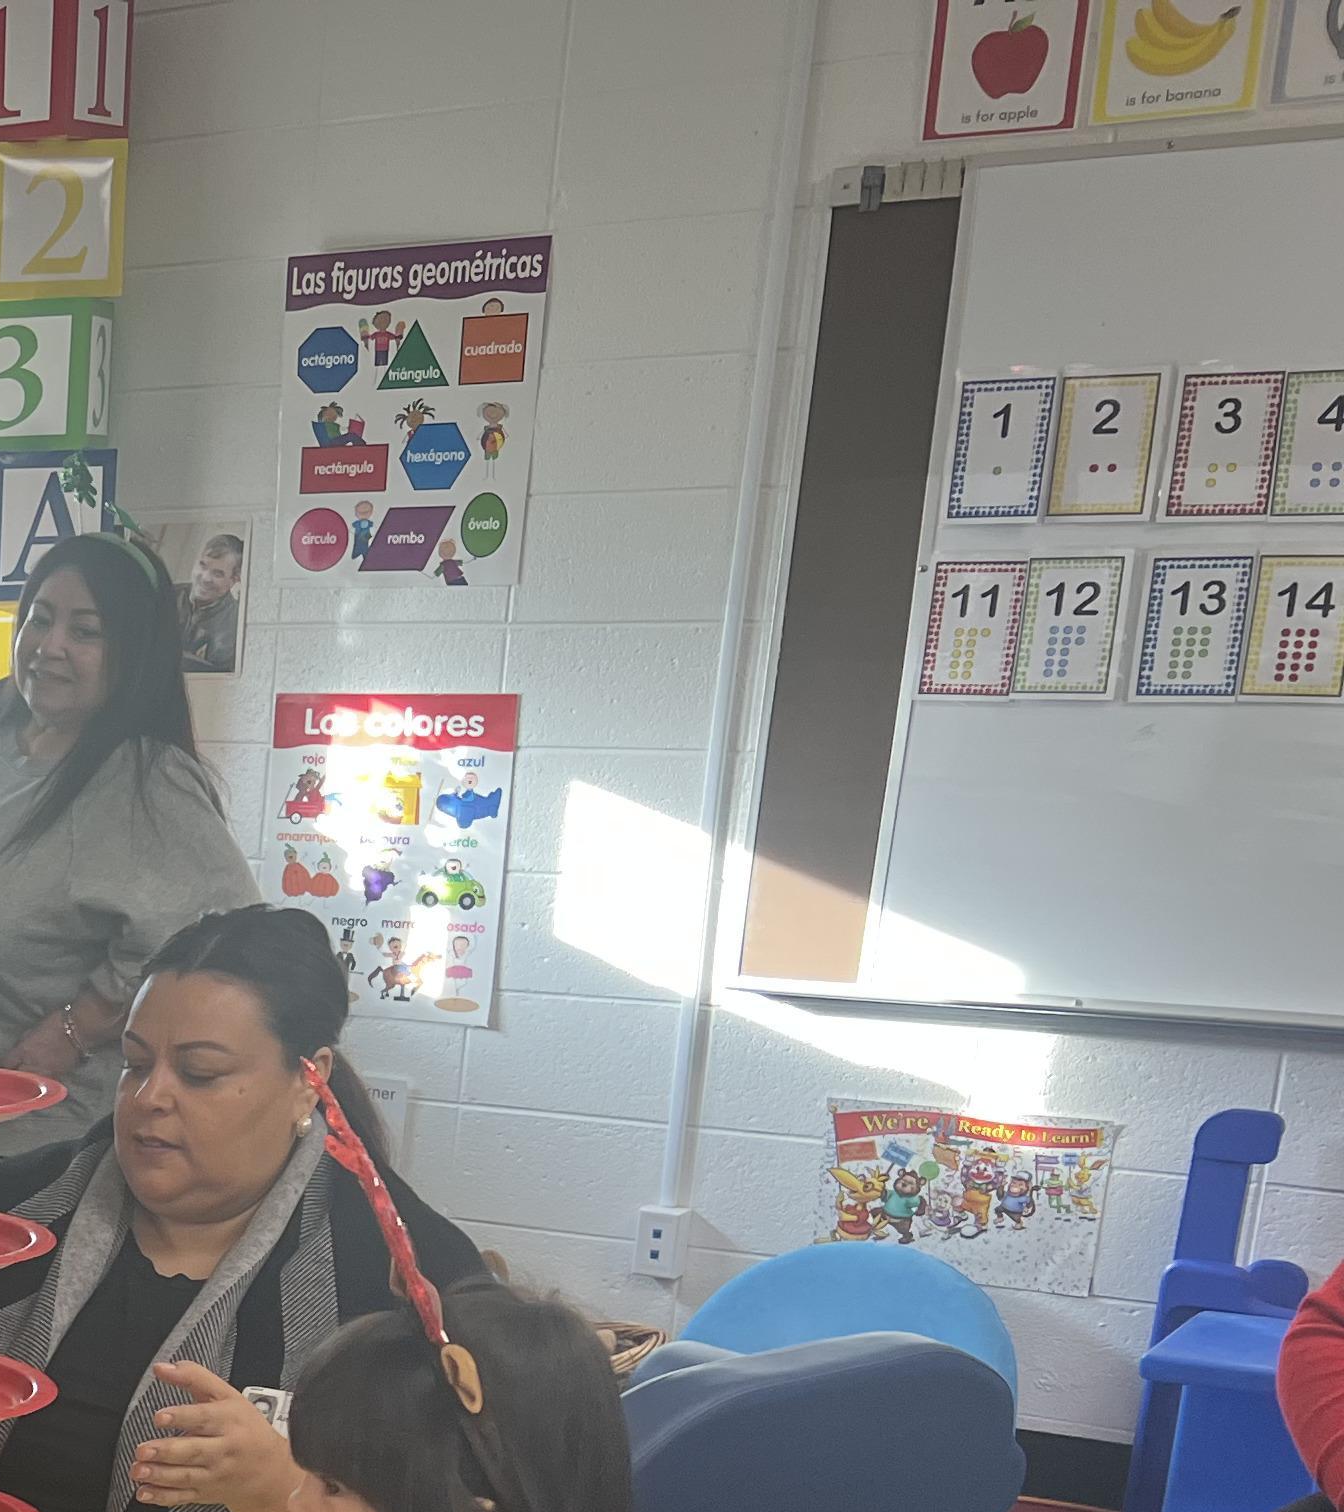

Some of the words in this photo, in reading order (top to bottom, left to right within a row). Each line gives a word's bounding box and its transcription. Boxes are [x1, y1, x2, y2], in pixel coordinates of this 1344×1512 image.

[88, 5, 111, 117] 1
[1125, 95, 1139, 106] is
[1141, 90, 1163, 105] for
[1165, 86, 1222, 102] banana
[961, 113, 972, 124] is
[975, 110, 996, 123] for
[998, 107, 1039, 124] apple
[21, 166, 89, 275] 2
[291, 267, 326, 296] Las
[331, 261, 403, 300] figuras
[408, 248, 544, 294] geométricas
[301, 351, 355, 369] octágono
[464, 340, 523, 356] cuadrado
[92, 324, 107, 428] 3
[388, 366, 441, 383] triángulo
[993, 403, 1012, 438] 1
[1092, 399, 1121, 435] 2
[1214, 397, 1243, 433] 3
[1317, 394, 1344, 432] 4
[314, 461, 374, 477] rectángulo
[406, 448, 465, 465] hexágono
[301, 533, 337, 545] círculo
[387, 532, 425, 544] rombo
[468, 516, 501, 531] óvalo
[951, 583, 1001, 618] 11
[1045, 581, 1102, 616] 12
[1170, 580, 1227, 616] 13
[1277, 582, 1336, 618] 14
[364, 707, 486, 738] colores
[302, 754, 326, 767] rojo
[457, 755, 485, 767] azul
[331, 915, 368, 928] negro
[861, 1112, 930, 1133] We're
[957, 1119, 1015, 1143] Ready
[1020, 1129, 1036, 1143] to
[1042, 1131, 1095, 1144] Learn!
